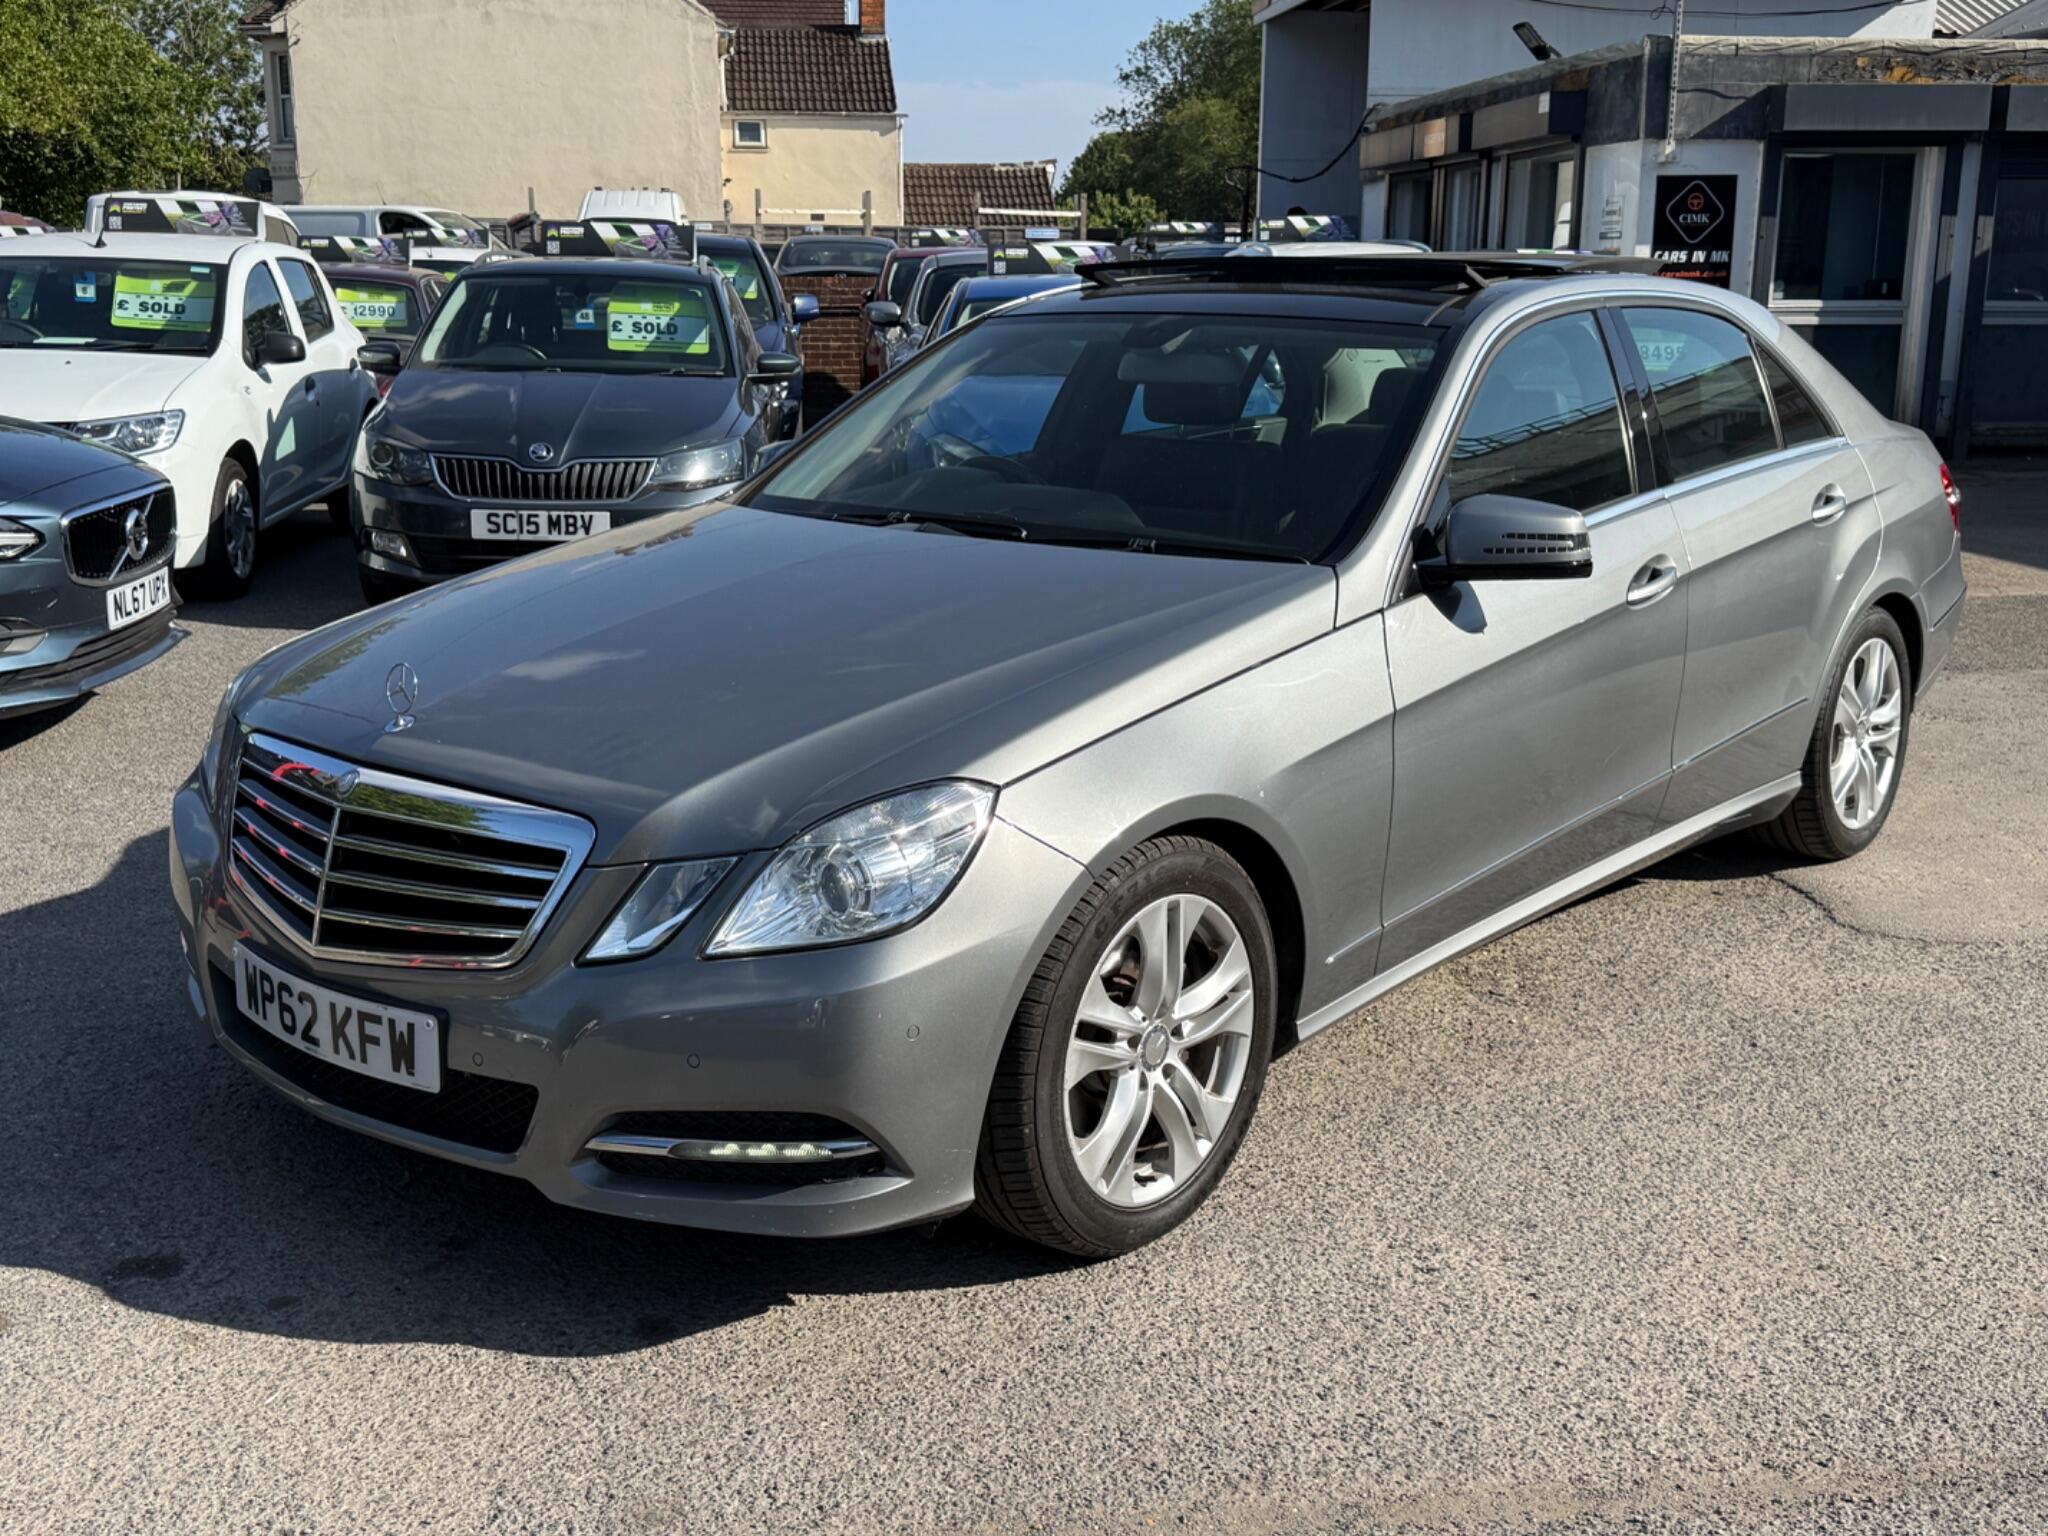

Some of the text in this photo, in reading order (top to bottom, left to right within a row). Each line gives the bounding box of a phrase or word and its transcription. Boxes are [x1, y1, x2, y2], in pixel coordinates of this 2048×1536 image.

[1679, 213, 1710, 223] CIMK
[1654, 250, 1730, 263] CARS IN MK
[117, 300, 186, 315] £ SOLD
[354, 304, 396, 317] 12990
[611, 320, 678, 335] £ SOLD
[486, 512, 593, 536] SC15 MBV
[113, 582, 146, 621] NL67
[244, 958, 416, 1077] WP62 KFW
